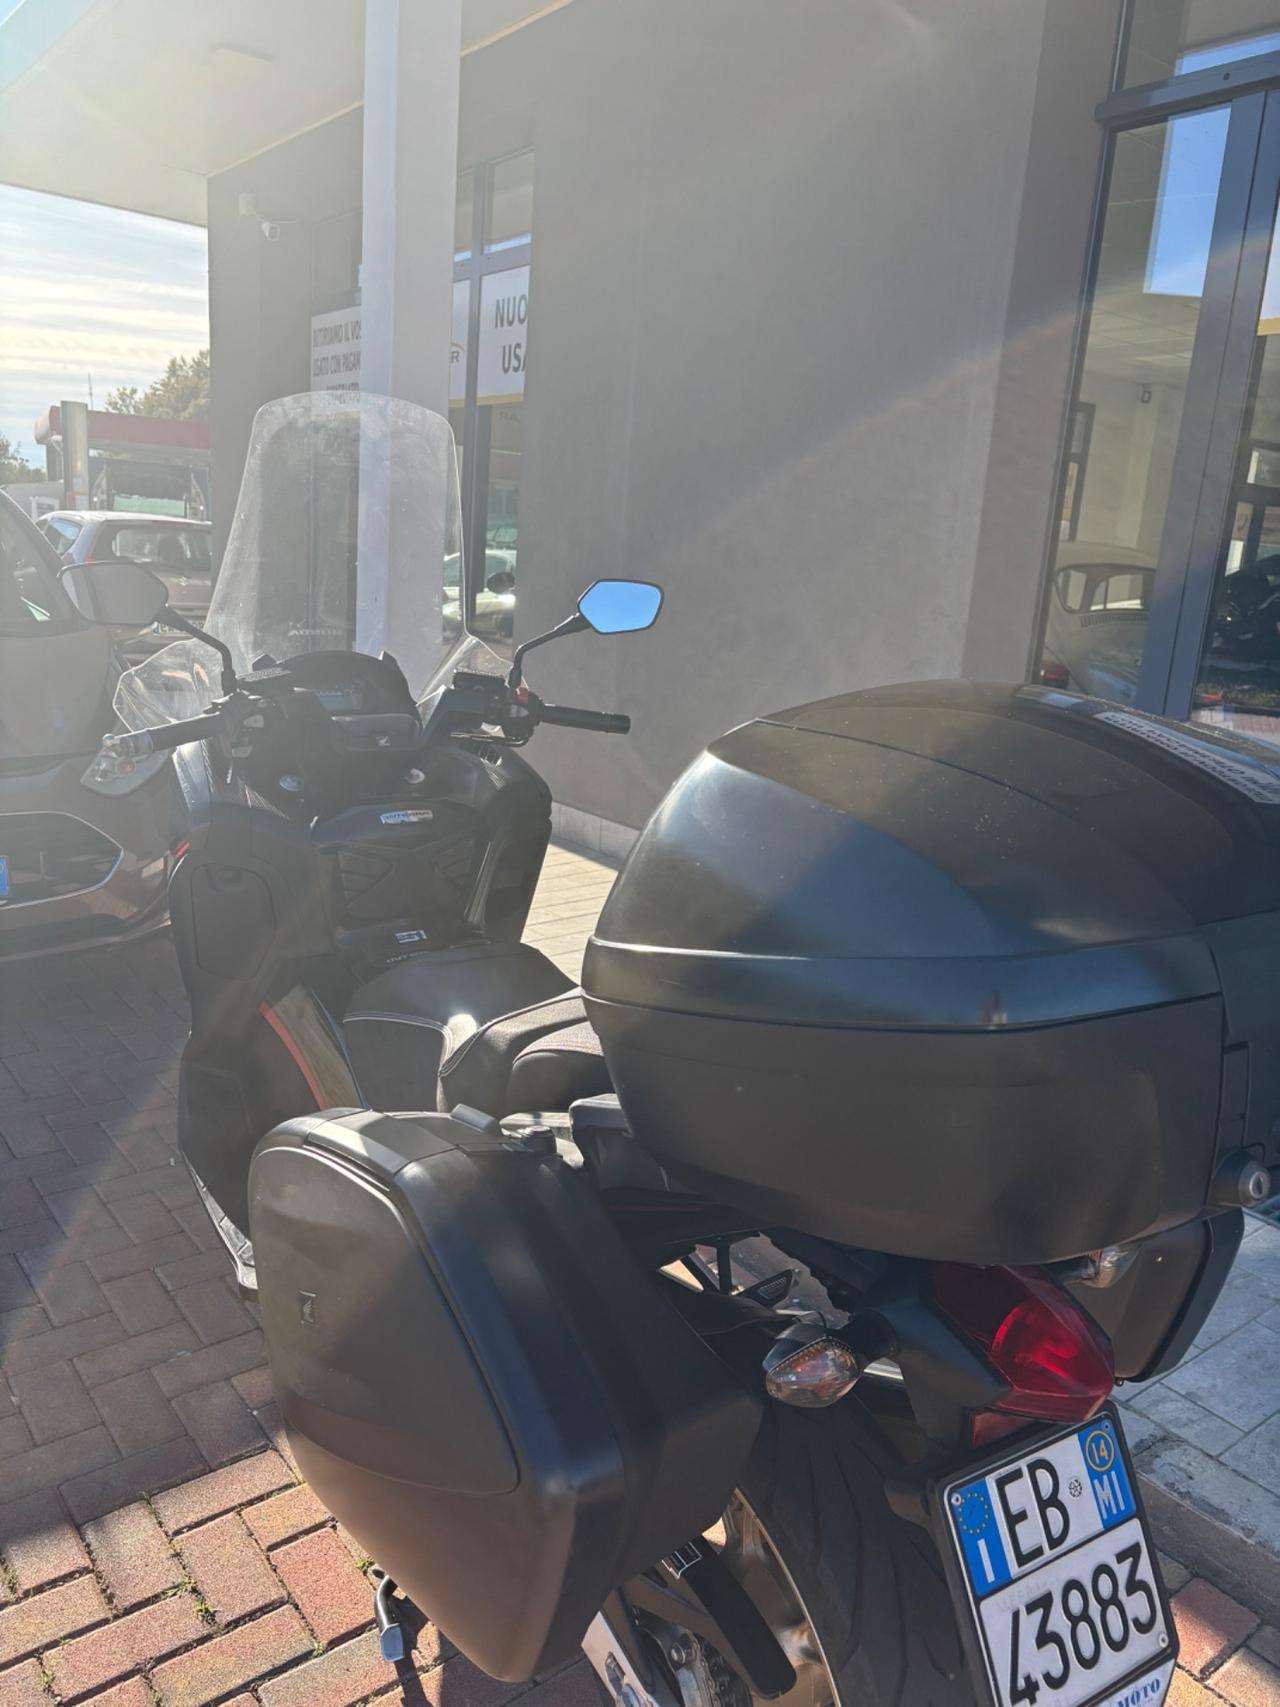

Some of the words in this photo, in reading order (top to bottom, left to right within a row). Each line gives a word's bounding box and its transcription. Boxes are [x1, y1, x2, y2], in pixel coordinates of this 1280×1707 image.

[1092, 1439, 1109, 1465] 14
[995, 1459, 1071, 1568] EB
[1093, 1470, 1126, 1520] MI
[977, 1538, 996, 1584] I
[1009, 1542, 1157, 1707] 43883
